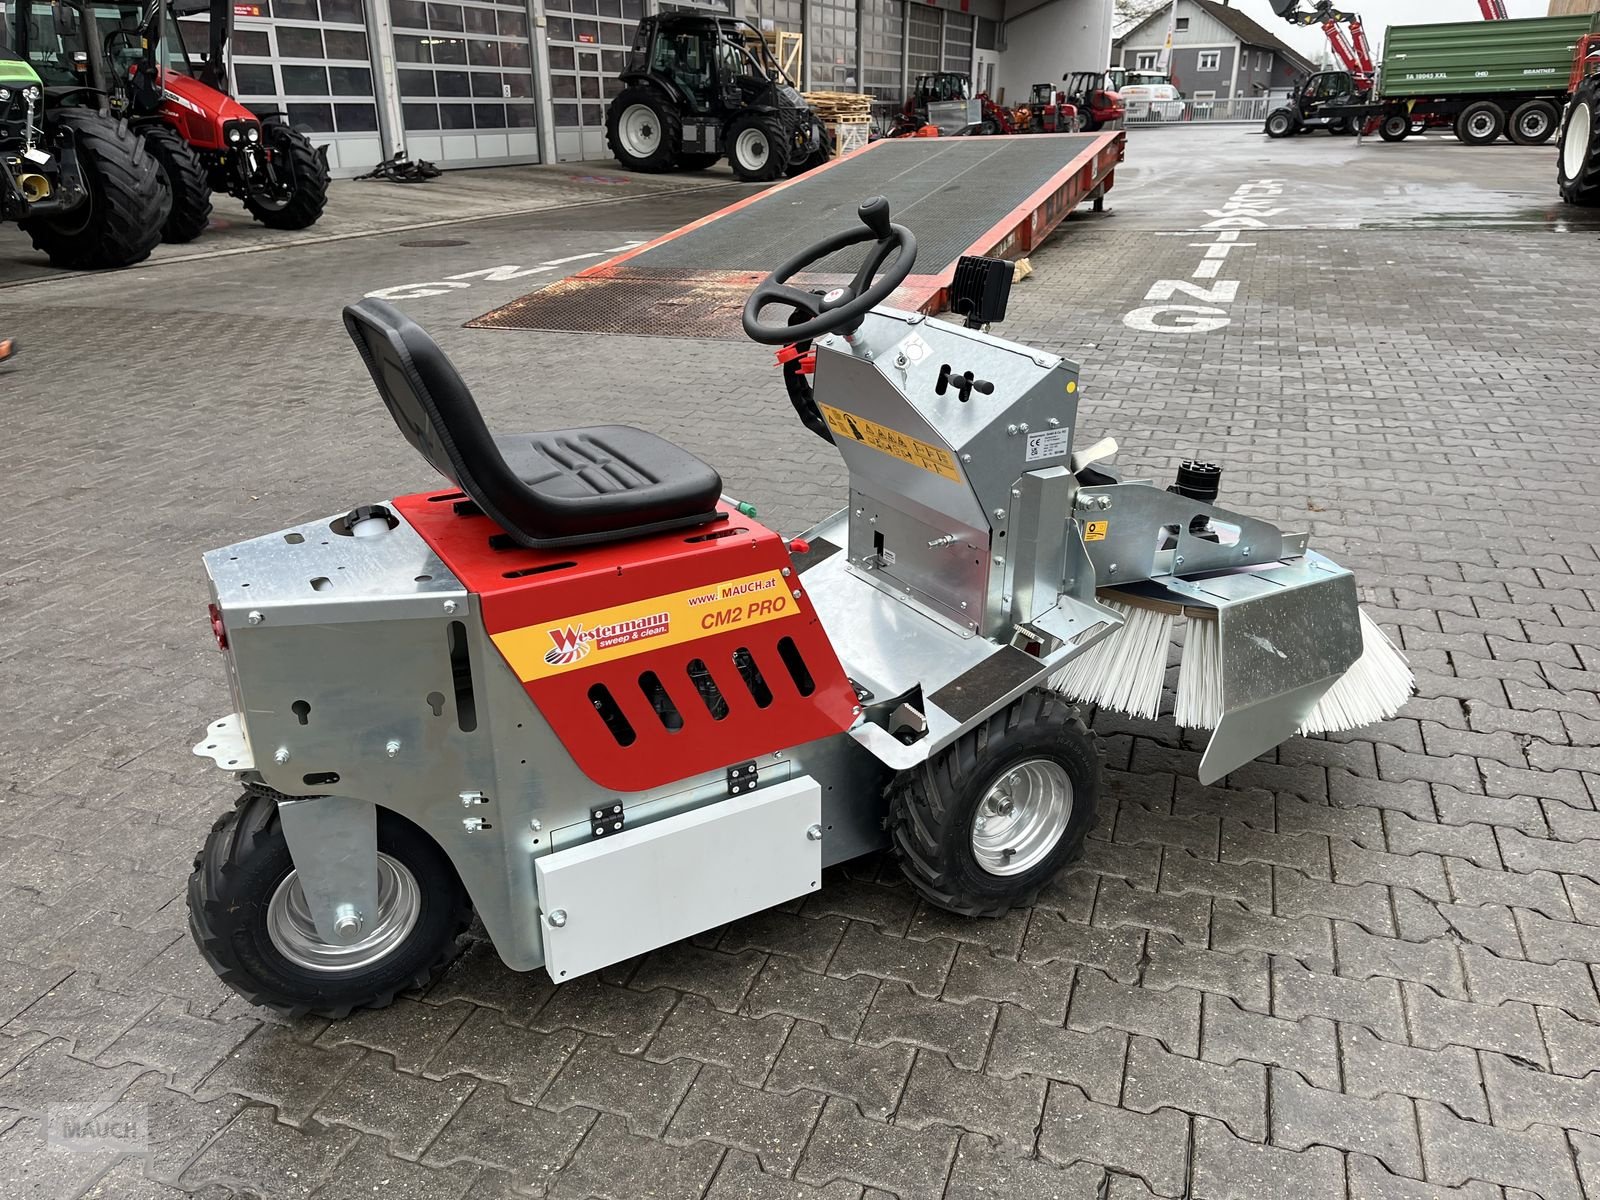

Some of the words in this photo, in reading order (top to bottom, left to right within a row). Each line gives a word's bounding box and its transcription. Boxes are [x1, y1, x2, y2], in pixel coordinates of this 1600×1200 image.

[701, 606, 743, 630] CM2
[747, 596, 786, 619] PRO
[548, 612, 669, 652] Westermann
[599, 635, 630, 649] sweep
[631, 632, 639, 641] &
[640, 626, 668, 638] clean.
